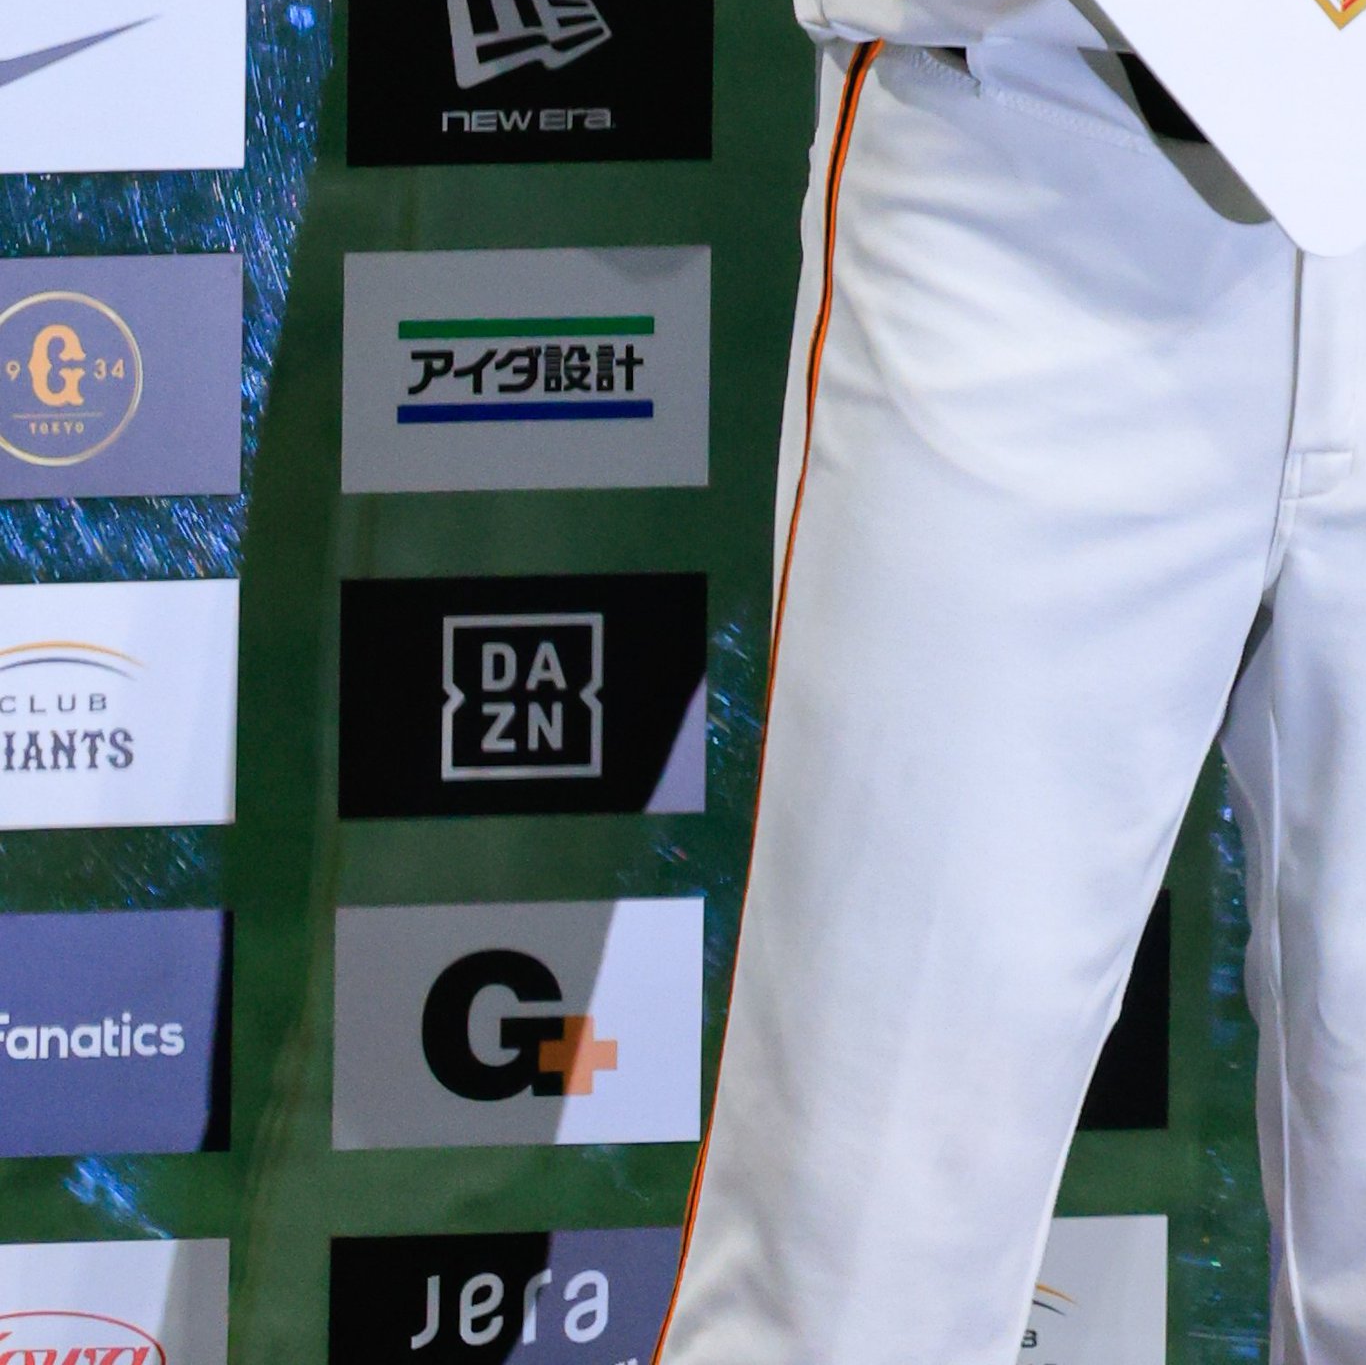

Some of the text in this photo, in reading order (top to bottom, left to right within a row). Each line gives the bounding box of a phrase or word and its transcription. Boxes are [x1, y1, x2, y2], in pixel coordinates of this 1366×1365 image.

[28, 325, 85, 406] G
[94, 359, 124, 380] 34
[408, 345, 644, 395] アイダ設計
[28, 420, 84, 433] TOKYO
[482, 641, 566, 691] DA
[0, 692, 108, 712] CLUB
[482, 702, 562, 752] ZN
[3, 730, 135, 771] IANTS
